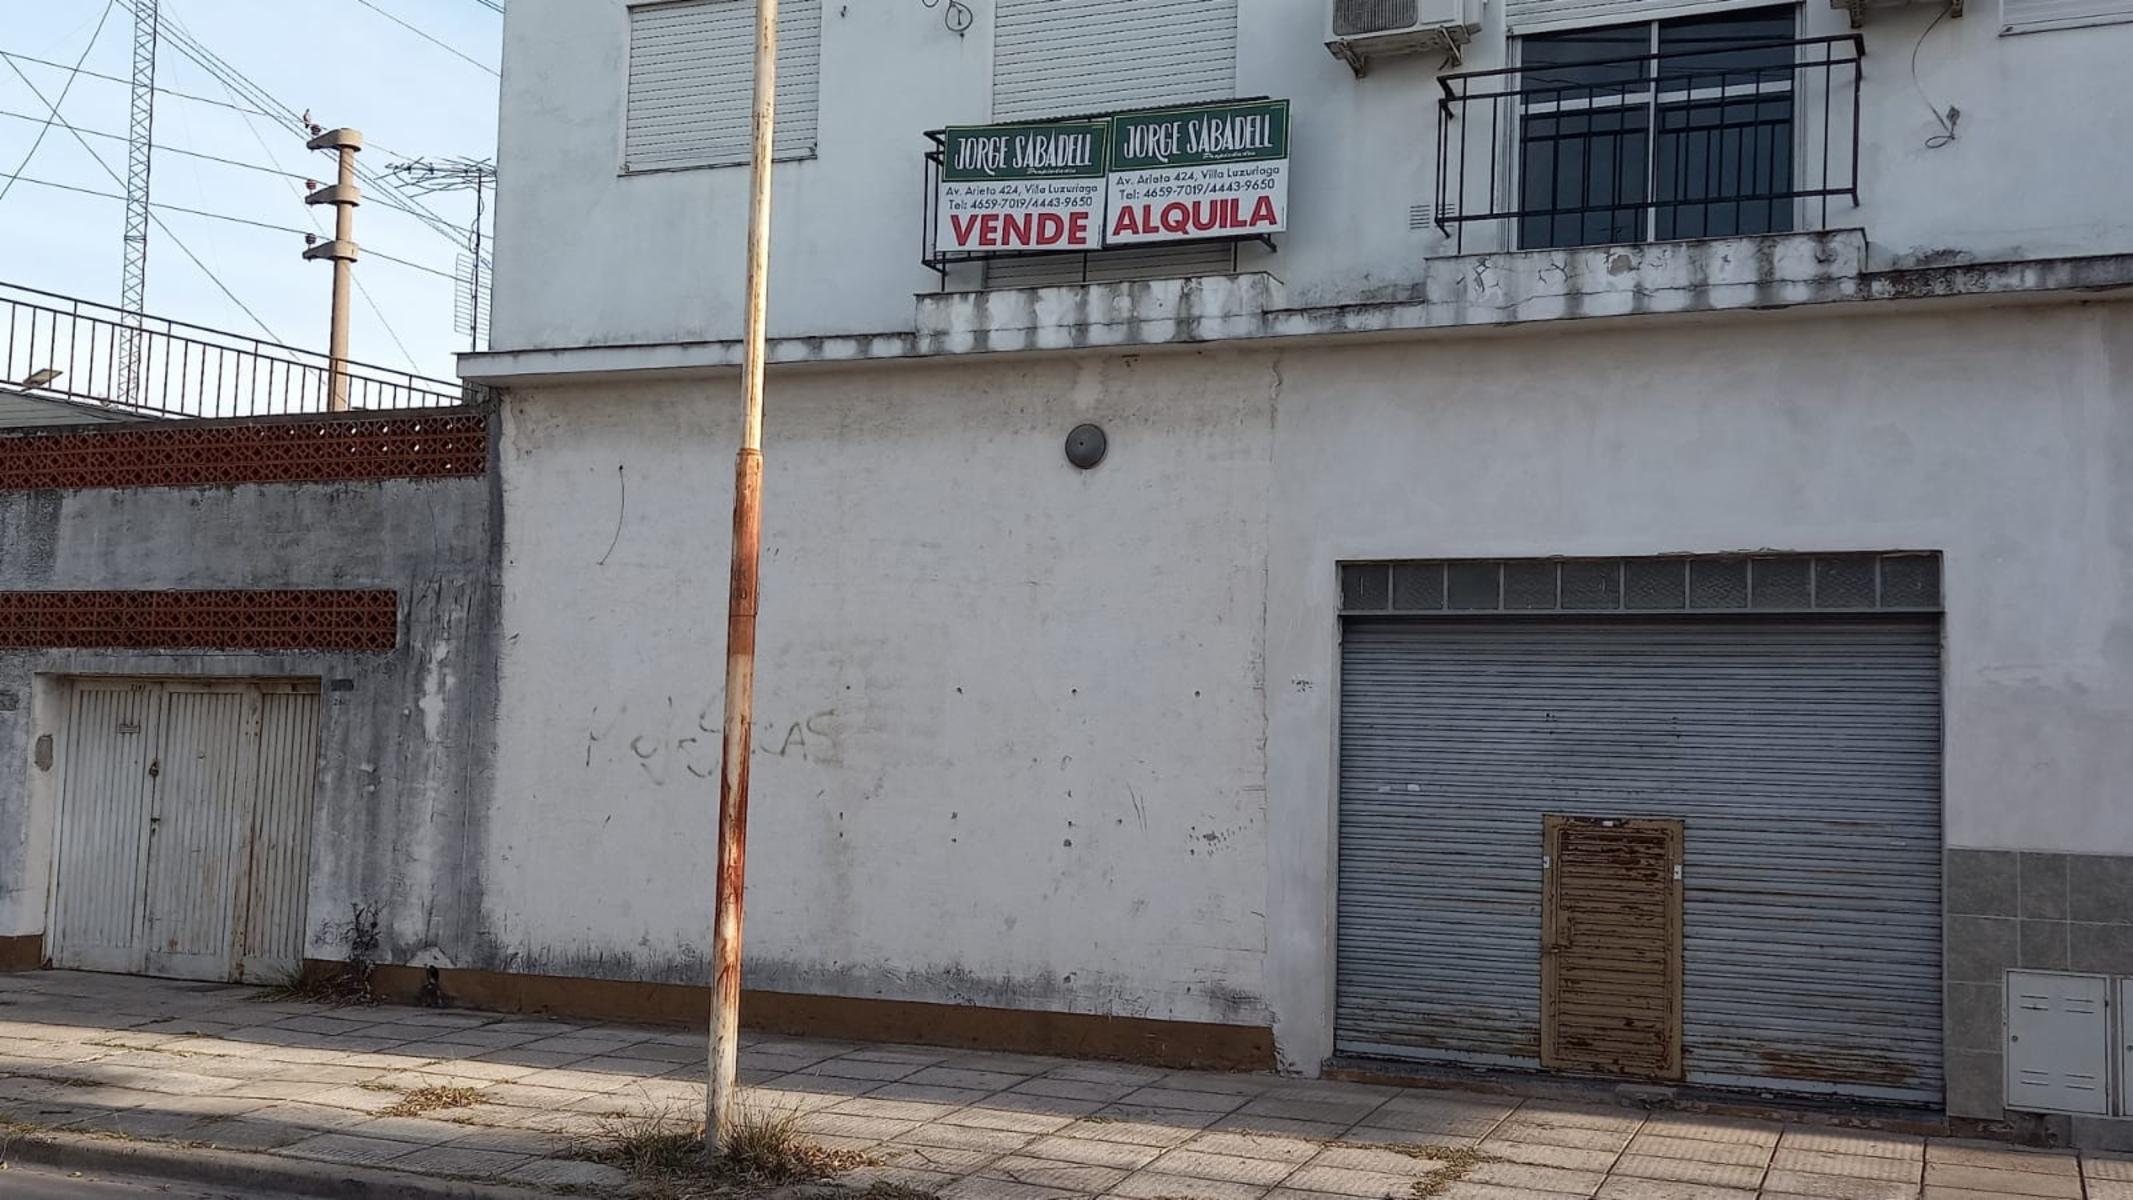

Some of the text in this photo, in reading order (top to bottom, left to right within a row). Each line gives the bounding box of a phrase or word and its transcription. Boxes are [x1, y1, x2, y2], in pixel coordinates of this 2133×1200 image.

[955, 129, 1092, 176] JORGE SABADELL
[1124, 112, 1273, 163] JORGE SABADELL
[998, 184, 1022, 197] 424,
[1174, 170, 1198, 183] 424,
[1200, 169, 1224, 180] Villa
[950, 212, 1089, 247] VENDE
[1112, 195, 1278, 236] ALQUILA
